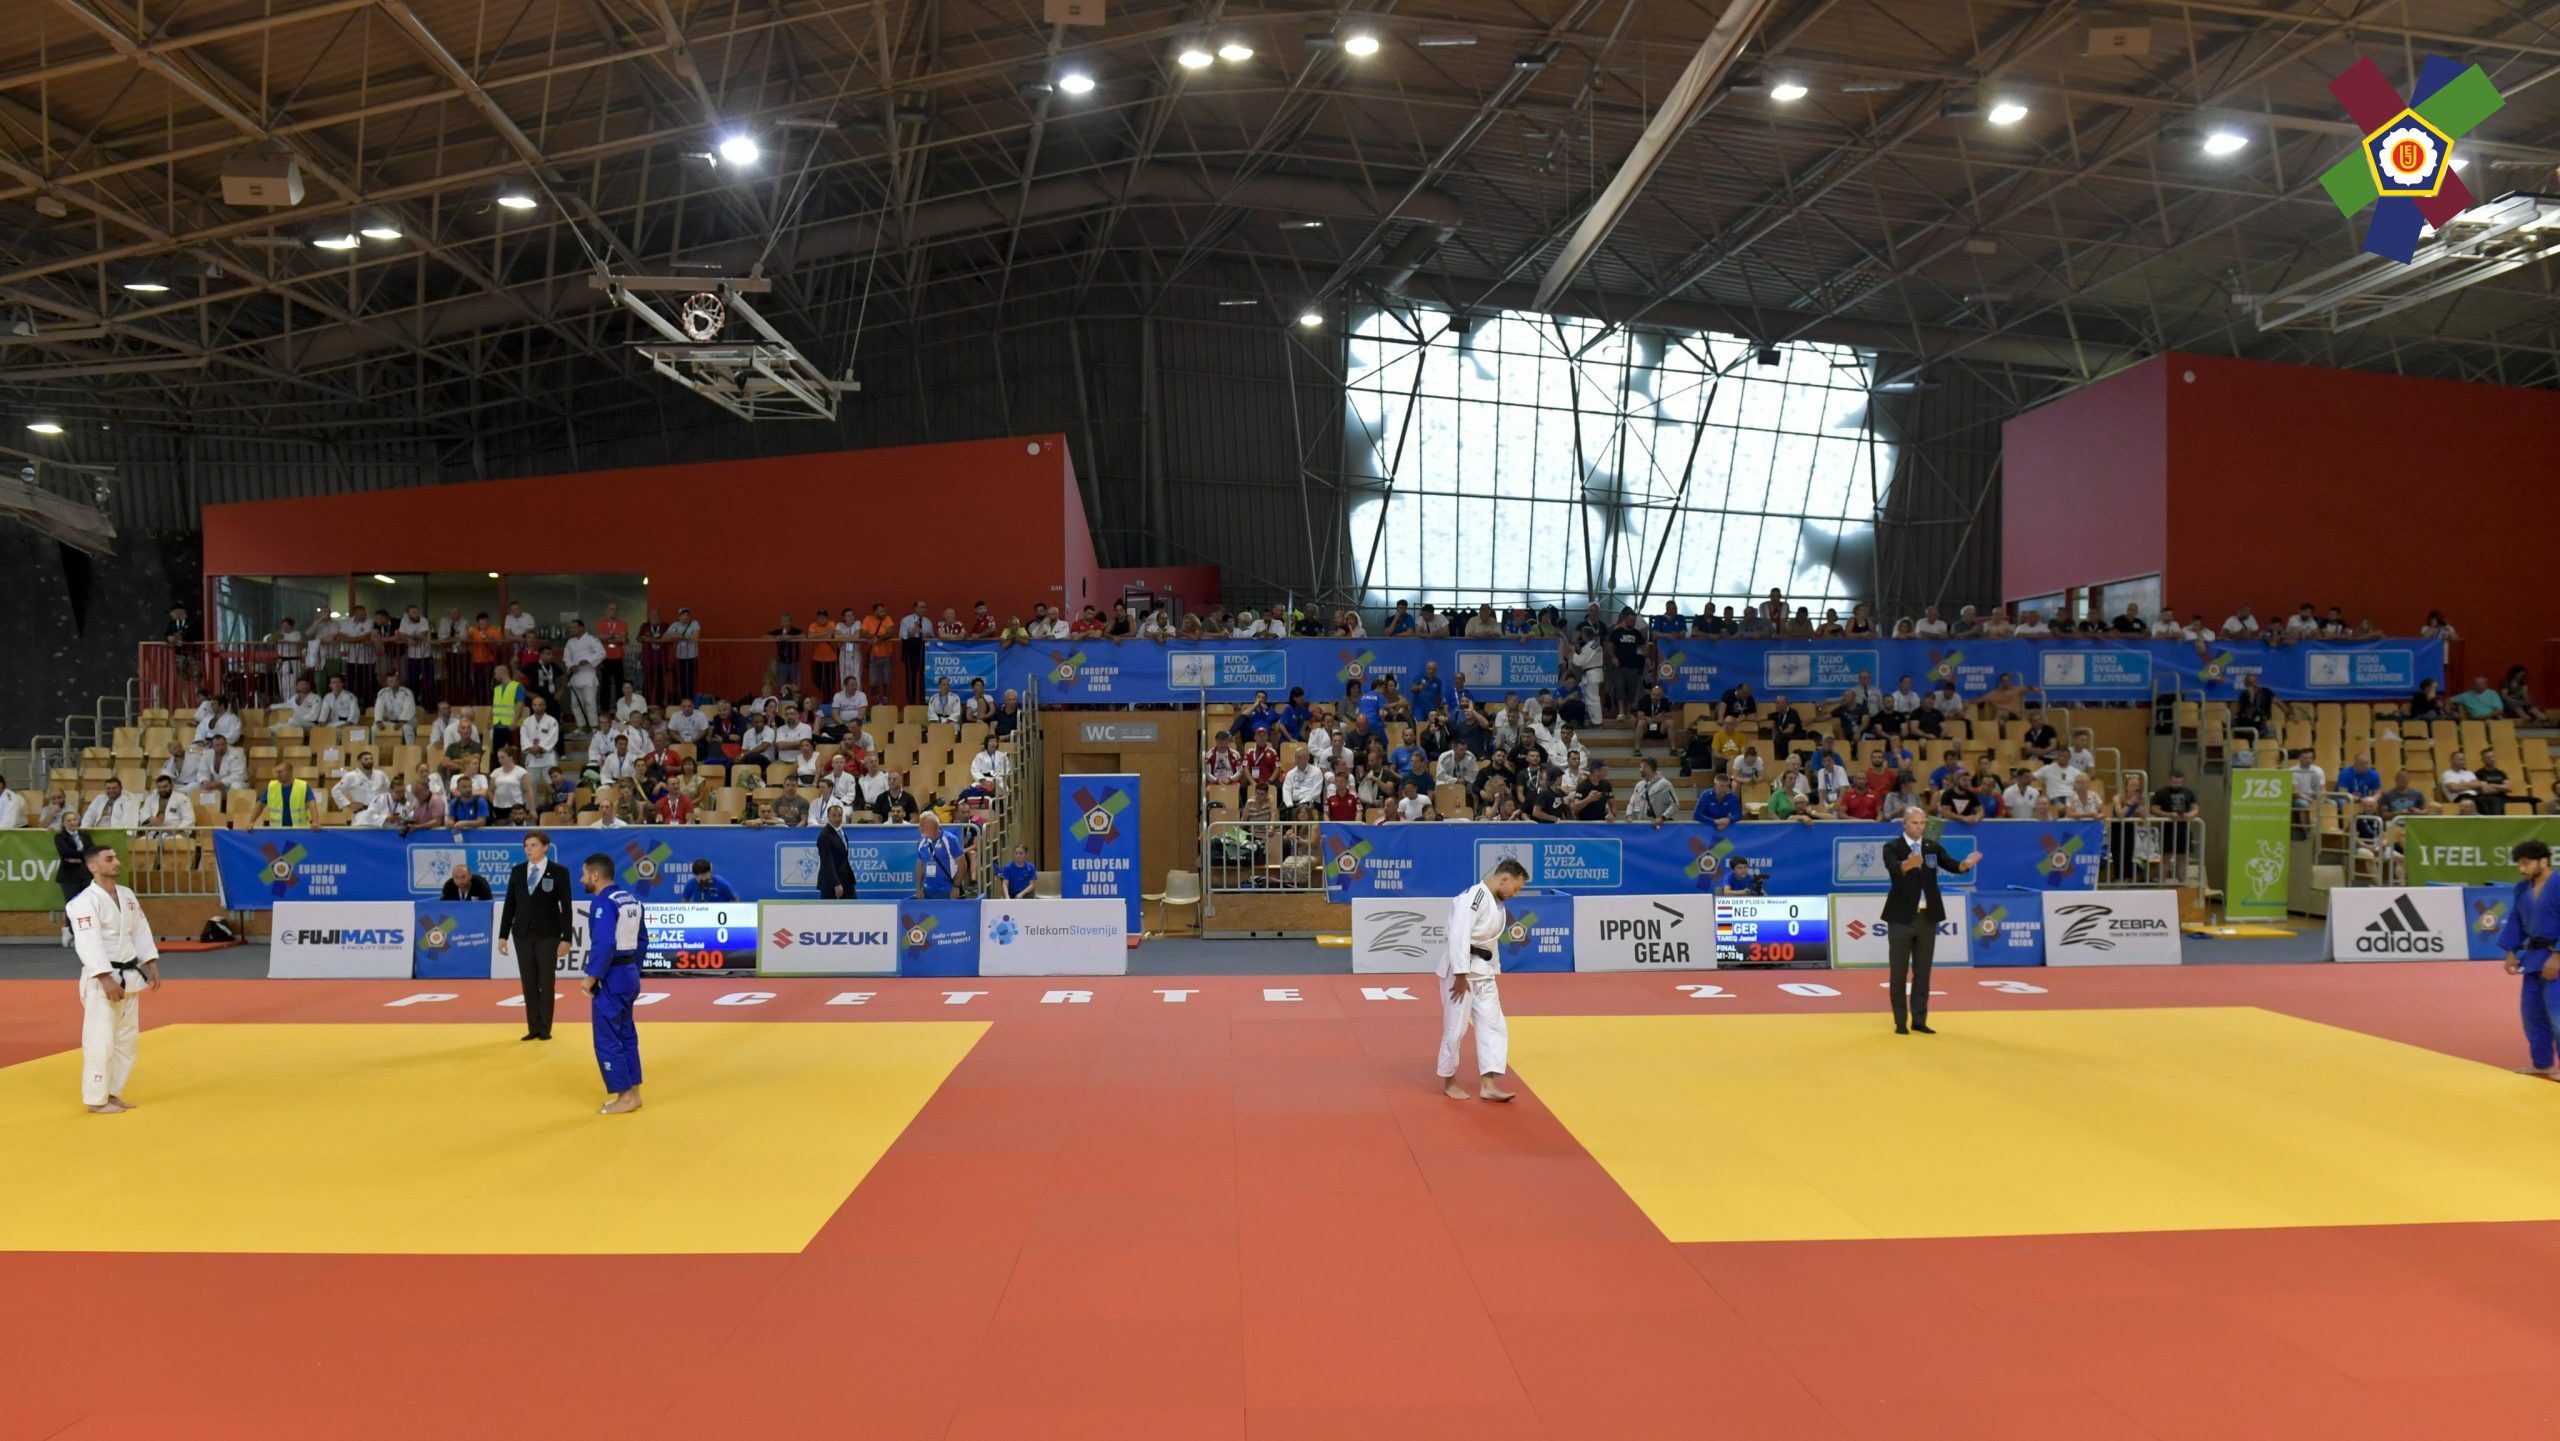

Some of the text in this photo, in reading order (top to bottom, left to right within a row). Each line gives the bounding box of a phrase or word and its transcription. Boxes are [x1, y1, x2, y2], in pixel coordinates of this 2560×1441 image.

[934, 657, 960, 666] JUDO
[1224, 656, 1248, 664] JUDO
[1510, 656, 1536, 664] JUDO
[934, 666, 968, 675] ZVEZA
[1080, 667, 1118, 675] EUROPEAN
[1224, 665, 1256, 674] ZVEZA
[1368, 666, 1407, 674] EUROPEAN
[1510, 665, 1543, 674] ZVEZA
[1680, 666, 1718, 674] EUROPEAN
[1090, 676, 1109, 684] JUDO
[1224, 674, 1276, 684] SLOVENIJE
[1088, 684, 1112, 692] UNION
[1687, 683, 1710, 691] UNION
[1086, 726, 1116, 740] WC
[2241, 778, 2282, 799] JZS
[477, 850, 509, 861] JUDO
[1544, 845, 1576, 856] JUDO
[2420, 846, 2430, 866] I
[2434, 846, 2488, 866] FEEL
[849, 860, 888, 870] VEZA
[1072, 858, 1130, 870] EUROPEAN
[1365, 858, 1412, 869] EUROPEAN
[1544, 857, 1585, 866] ZVEZA
[1725, 858, 1772, 868] EPEAN
[299, 864, 346, 874] EUROPEAN
[478, 863, 513, 873] ZVEZ
[1086, 871, 1115, 882] JUDO
[1377, 870, 1400, 880] JUDO
[1544, 868, 1609, 880] SLOVENIJE
[312, 875, 335, 884] JUDO
[308, 885, 338, 895] UNION
[1082, 884, 1118, 895] UNION
[1374, 880, 1403, 890] UNION
[1734, 904, 1798, 918] NED 0
[660, 912, 728, 926] GEO 0
[1600, 919, 1662, 940] IPPON
[1734, 920, 1800, 936] GER 0
[1872, 922, 1958, 936] SKI
[2001, 922, 2040, 930] EUROPEAN
[2108, 920, 2168, 930] ZEBRA
[298, 929, 404, 945] FUJIMATS
[660, 928, 728, 944] AZE 0
[1531, 928, 1570, 936] EUROPEAN
[2011, 930, 2031, 938] JUDO
[798, 931, 888, 946] SUZUKI
[1540, 936, 1560, 944] JUDO
[2008, 939, 2034, 947] UNION
[2356, 931, 2444, 953] adidas
[1538, 944, 1562, 952] UNION
[1634, 942, 1690, 964] GEAR
[1716, 943, 1794, 960] FINAL 3:00
[676, 950, 724, 969] 3:00
[1736, 952, 1744, 960] kg
[663, 960, 672, 968] kg
